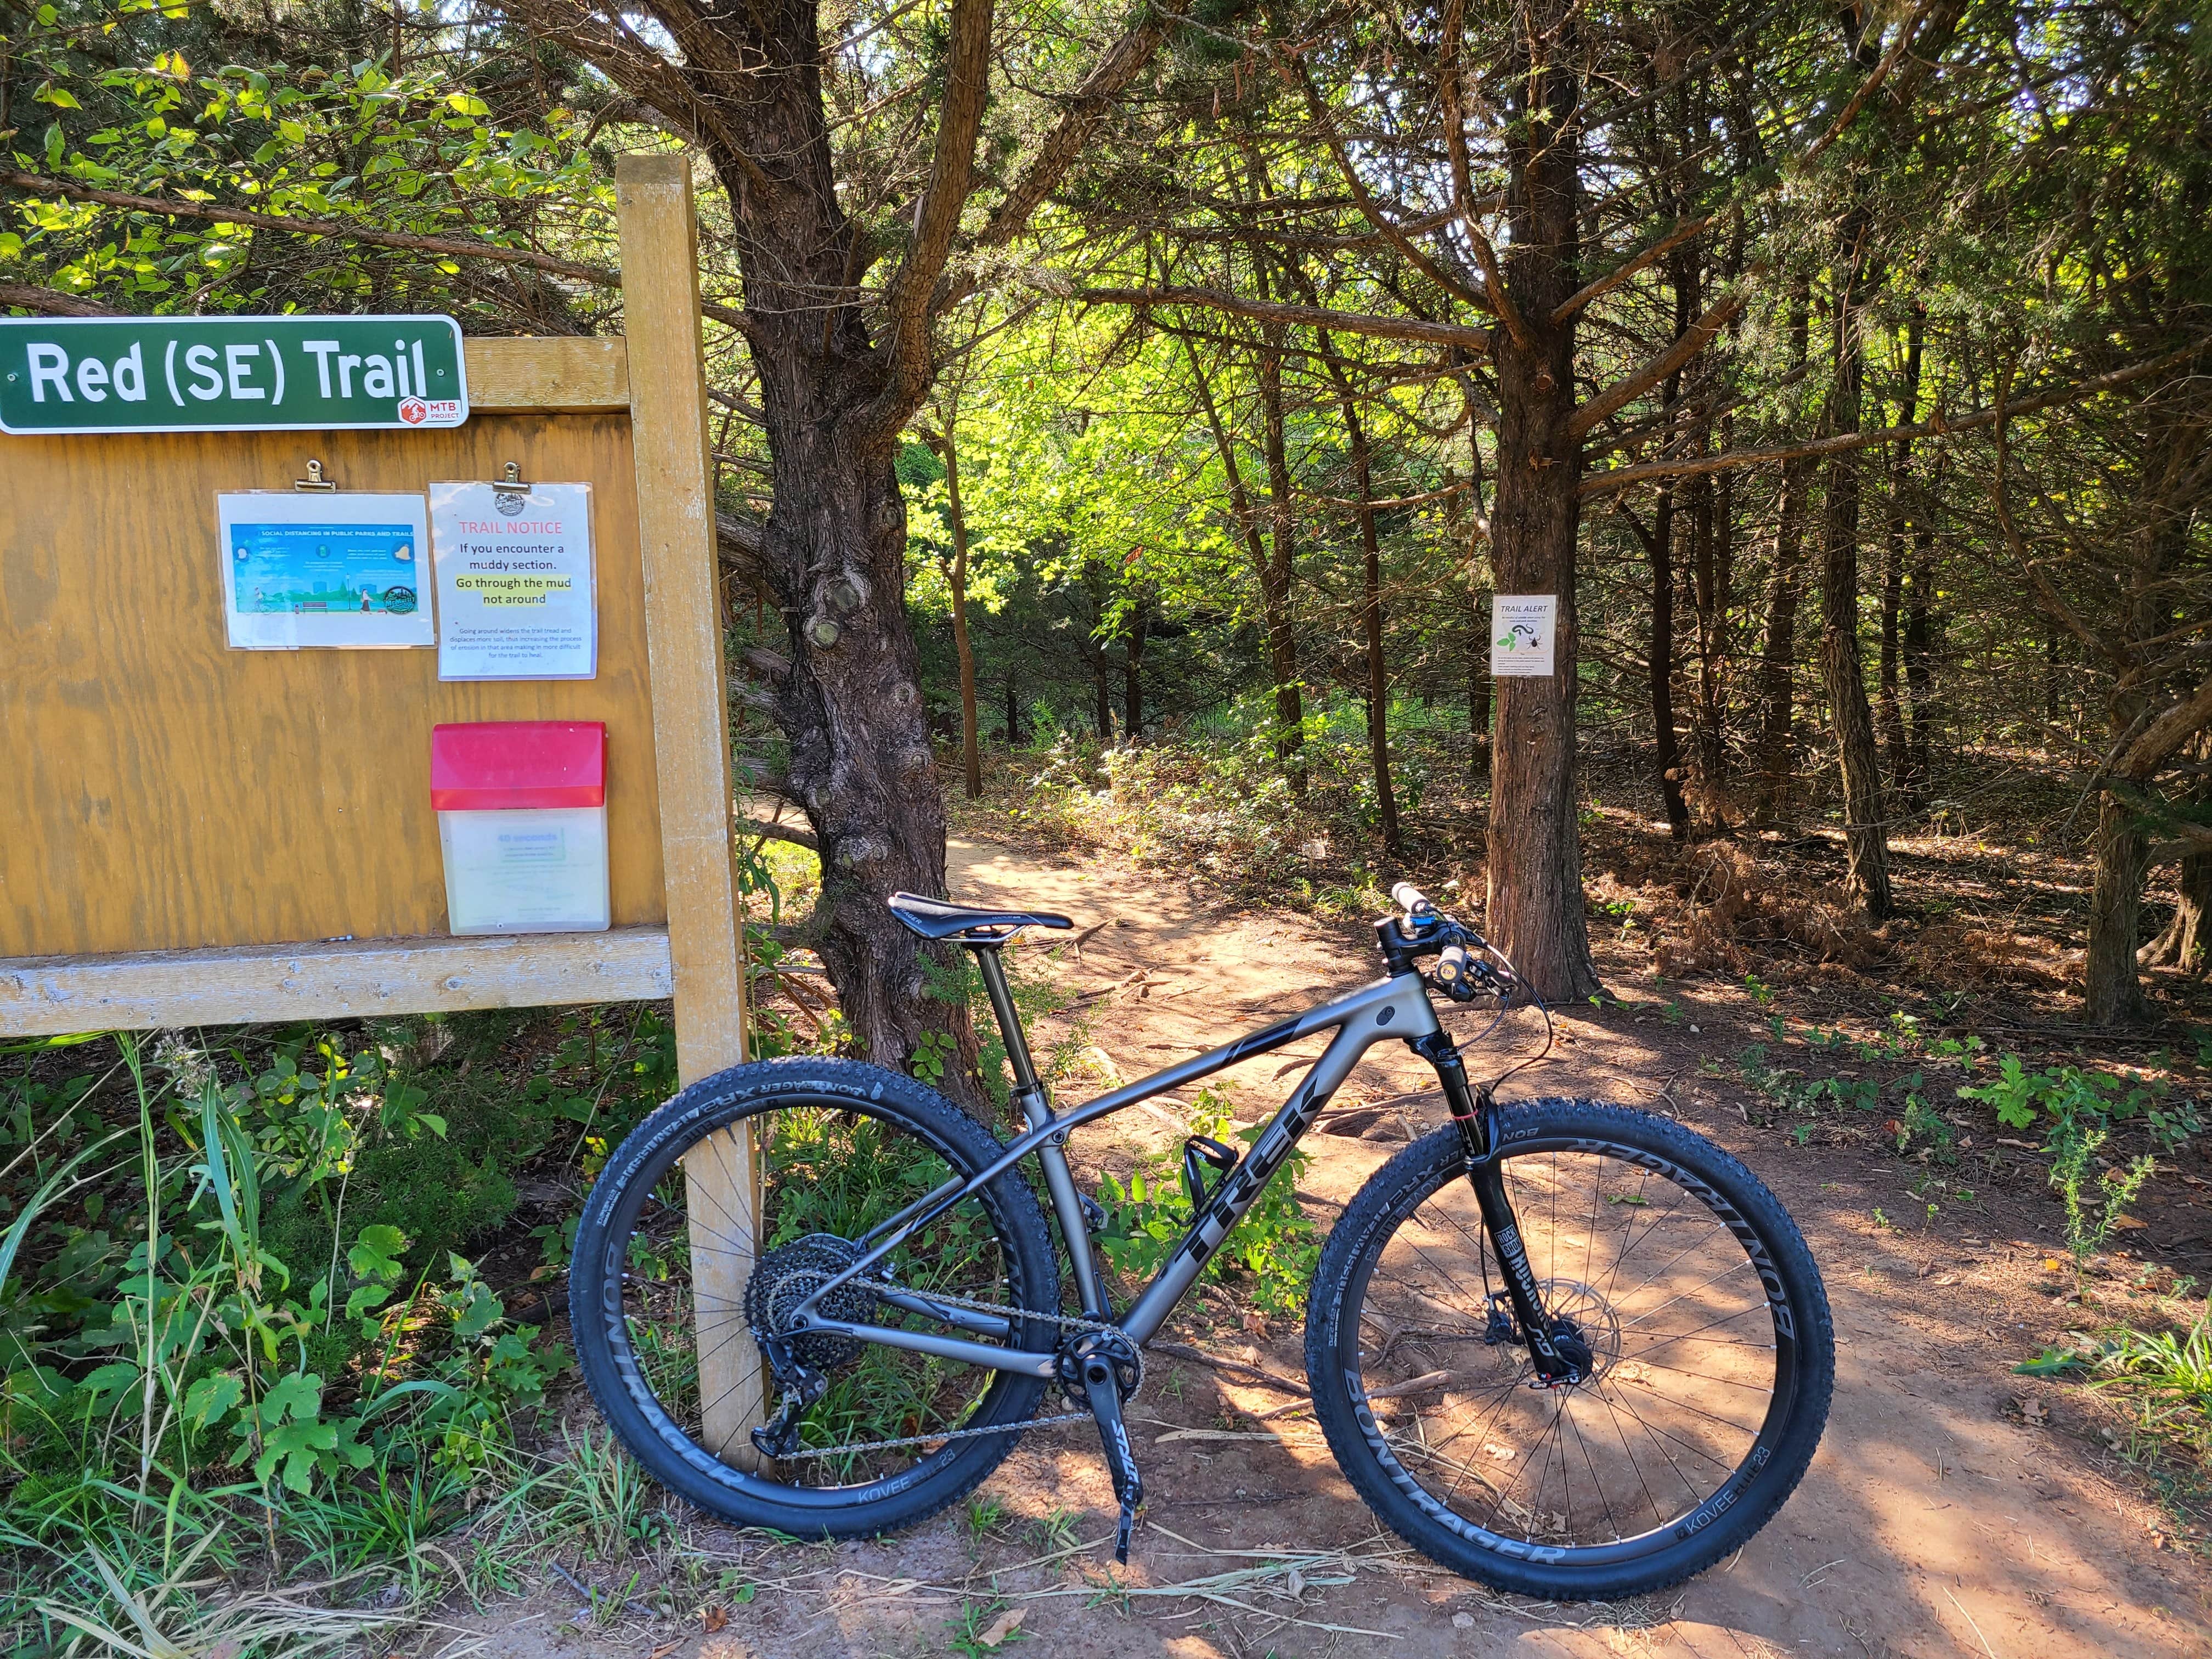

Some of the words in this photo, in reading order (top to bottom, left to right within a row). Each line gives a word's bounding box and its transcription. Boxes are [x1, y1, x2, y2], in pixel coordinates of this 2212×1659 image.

[26, 340, 147, 402] Red
[165, 340, 284, 406] (SE)
[303, 339, 427, 398] Trail
[430, 402, 456, 411] MTB
[459, 522, 503, 534] TRAIL
[507, 522, 562, 534] NOTICE
[460, 543, 469, 553] If
[471, 545, 492, 555] you
[496, 544, 555, 553] encounter
[470, 560, 509, 571] muddy
[512, 560, 557, 569] section.
[456, 578, 472, 588] Go
[476, 578, 521, 590] through
[524, 578, 543, 588] the
[546, 578, 571, 588] mud
[483, 595, 503, 603] not
[506, 594, 546, 603] around
[1175, 1076, 1333, 1263] TREK
[1390, 1164, 1435, 1204] XR2
[1395, 1173, 1444, 1216] KOVEE
[1373, 1215, 1400, 1245] ELITE
[1497, 1227, 1516, 1244] ROCK
[1566, 1139, 1795, 1340] BONTRAGER
[1365, 1244, 1381, 1262] 23
[1504, 1238, 1521, 1255] SHOX
[604, 1242, 745, 1486] BONTRAGER
[858, 1476, 911, 1504] KOVEE
[939, 1448, 956, 1466] 23
[1344, 1368, 1566, 1564] BONTRAGER
[1685, 1489, 1738, 1534] KOVEE
[1753, 1446, 1770, 1466] 23
